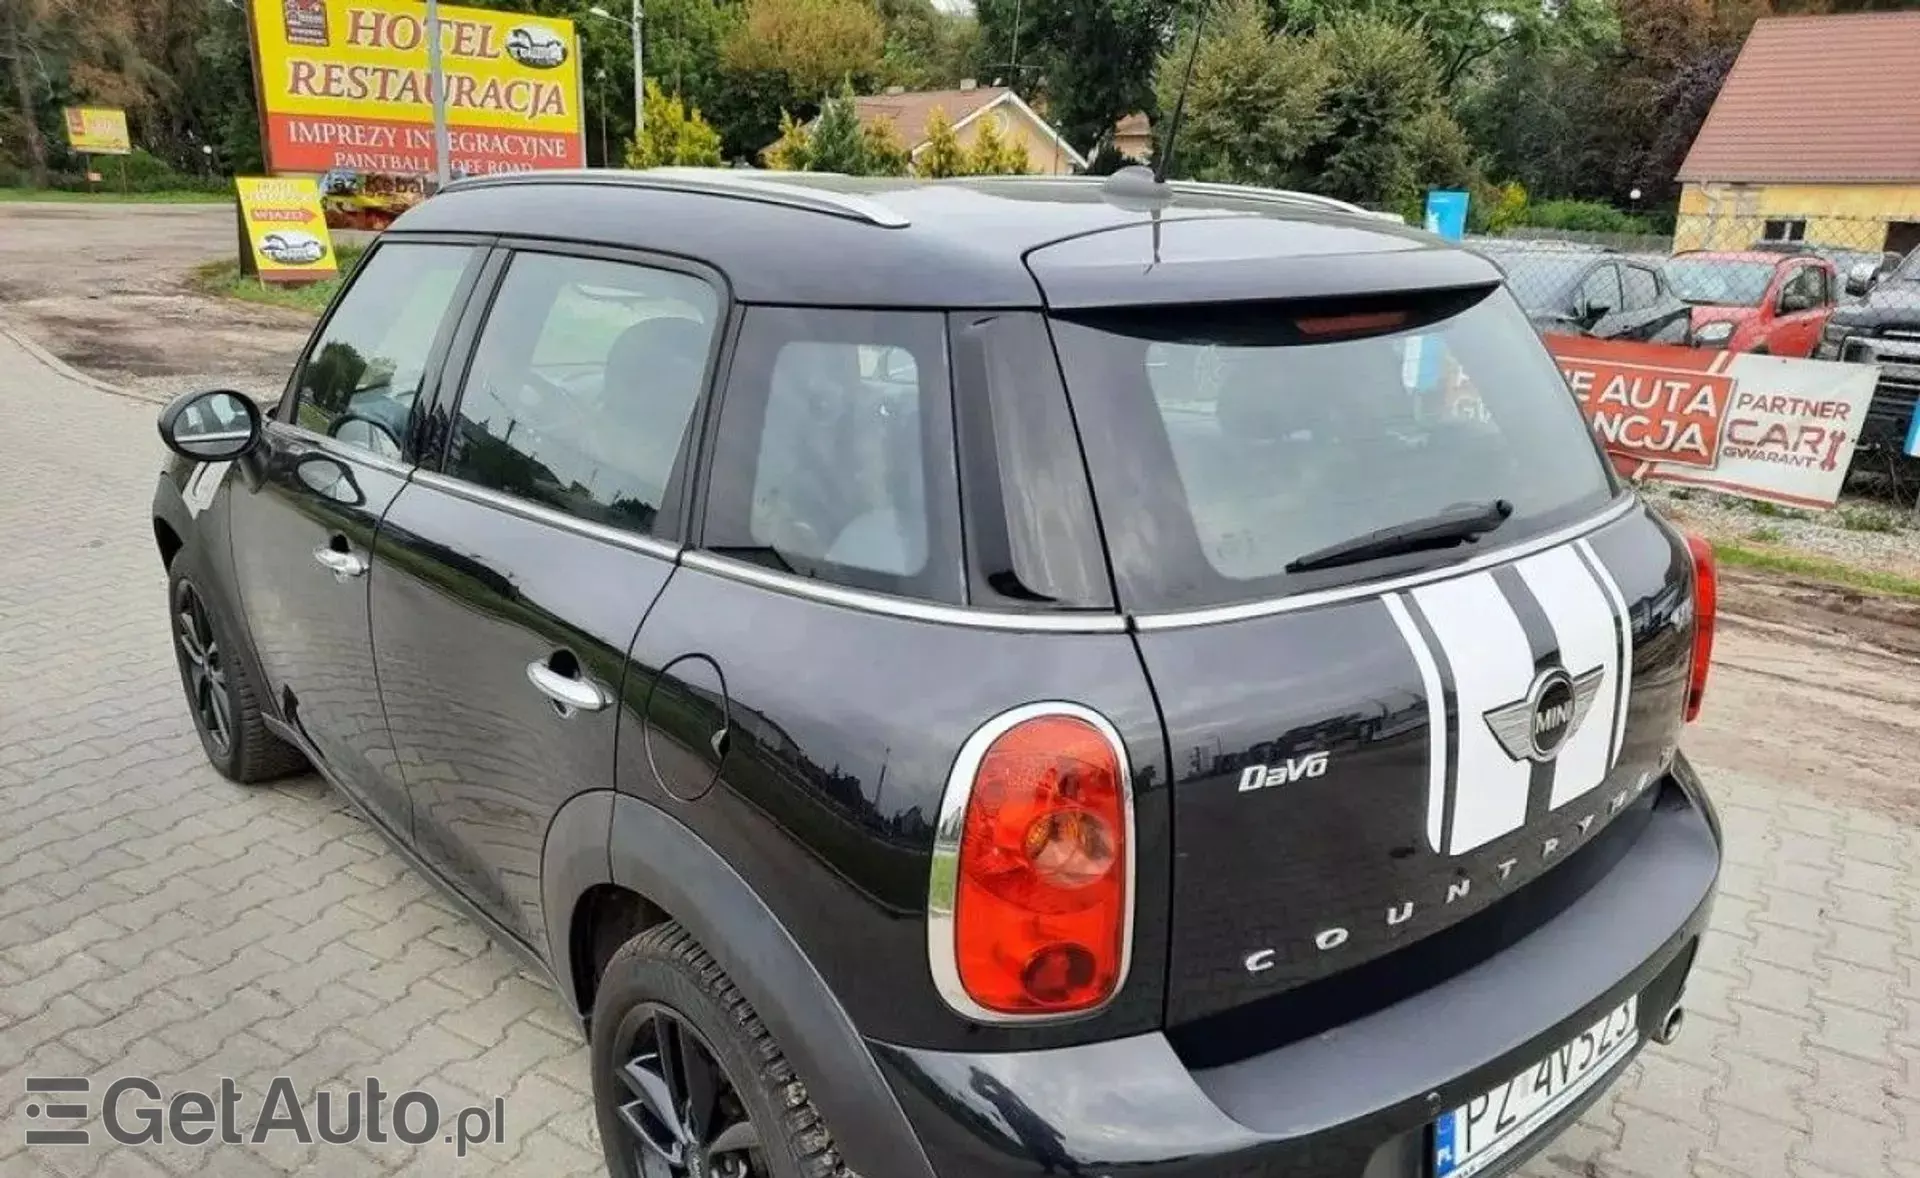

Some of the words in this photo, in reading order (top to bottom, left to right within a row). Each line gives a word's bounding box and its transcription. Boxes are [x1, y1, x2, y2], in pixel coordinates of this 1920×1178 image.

[288, 61, 566, 120] RESTAURACJA
[289, 120, 397, 149] IMPREZY
[404, 128, 567, 159] INEGRACYJNE
[1597, 374, 1717, 418] AUTA
[1736, 392, 1852, 420] PARTNER
[1726, 418, 1826, 455] CAR
[1721, 446, 1818, 468] GWARANT
[1535, 701, 1573, 734] MINI
